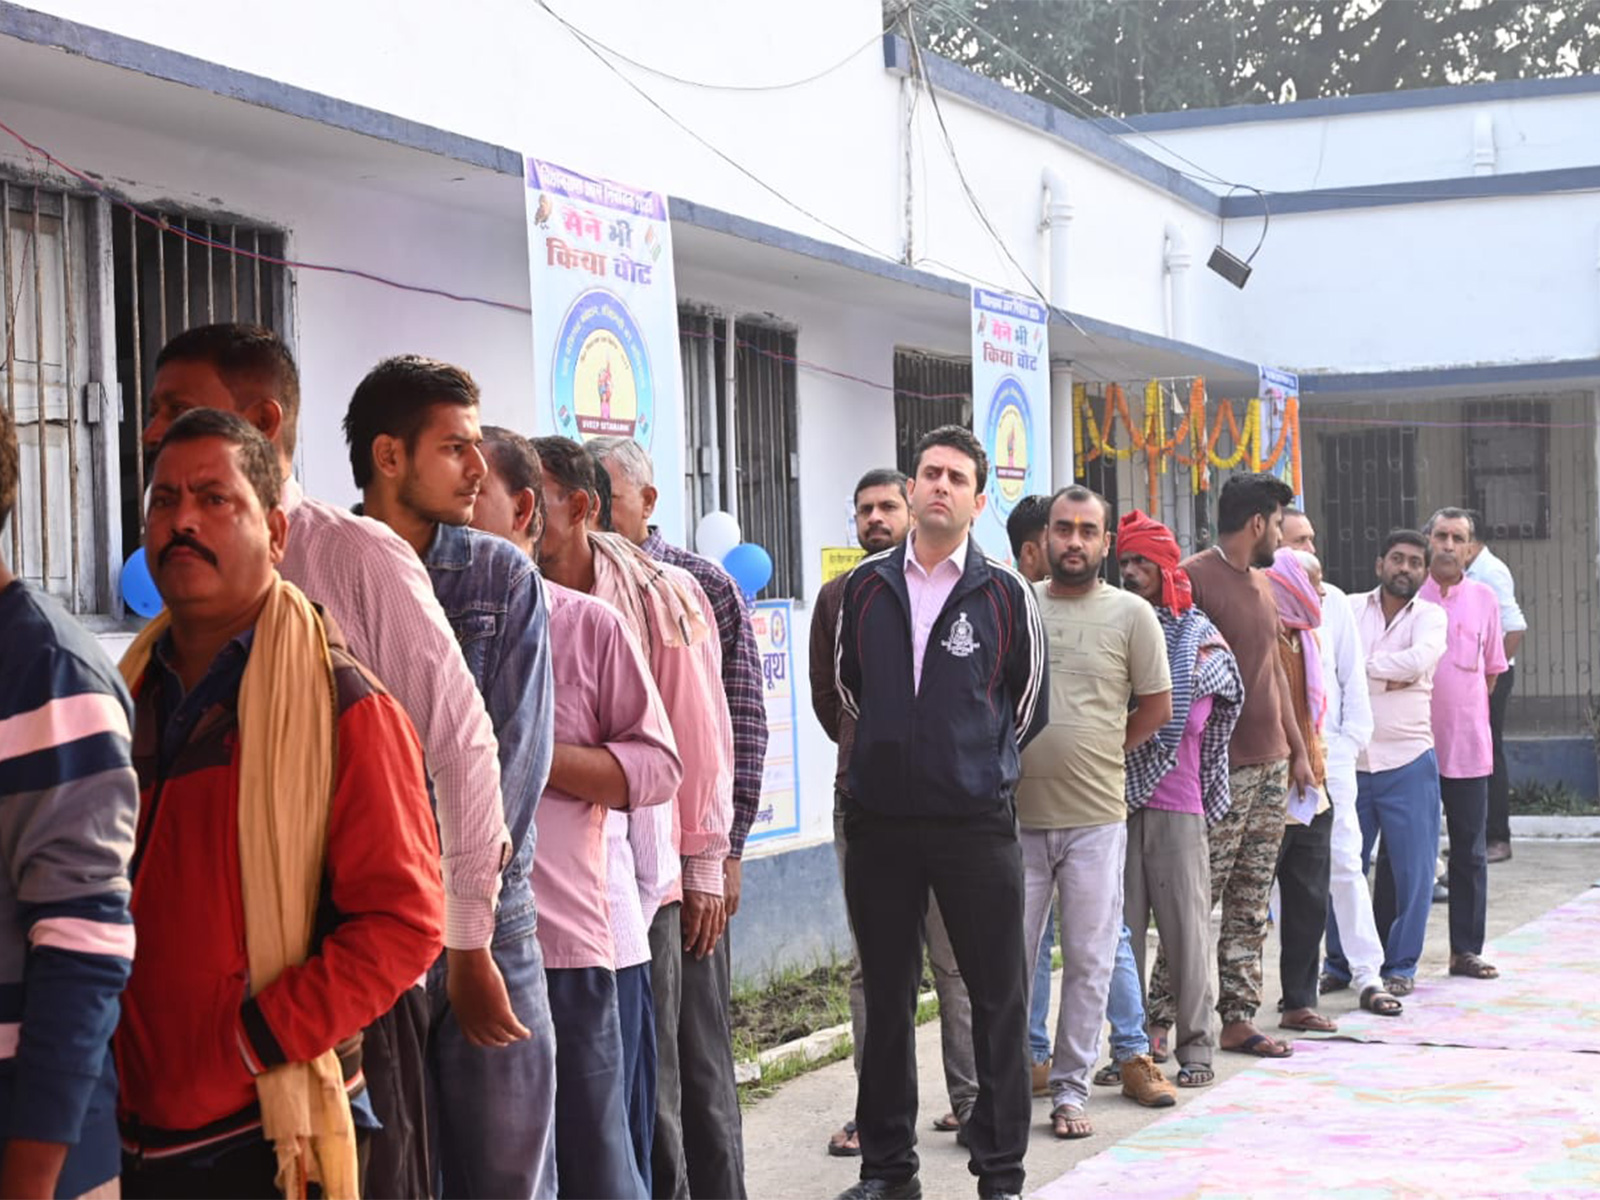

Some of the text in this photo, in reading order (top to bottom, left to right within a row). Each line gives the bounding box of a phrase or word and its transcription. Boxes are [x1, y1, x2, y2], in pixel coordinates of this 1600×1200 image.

[609, 218, 634, 249] भी
[546, 237, 652, 285] किया वोट
[1015, 325, 1028, 346] भी
[983, 341, 1037, 371] किया वोट
[762, 652, 786, 690] बूथ
